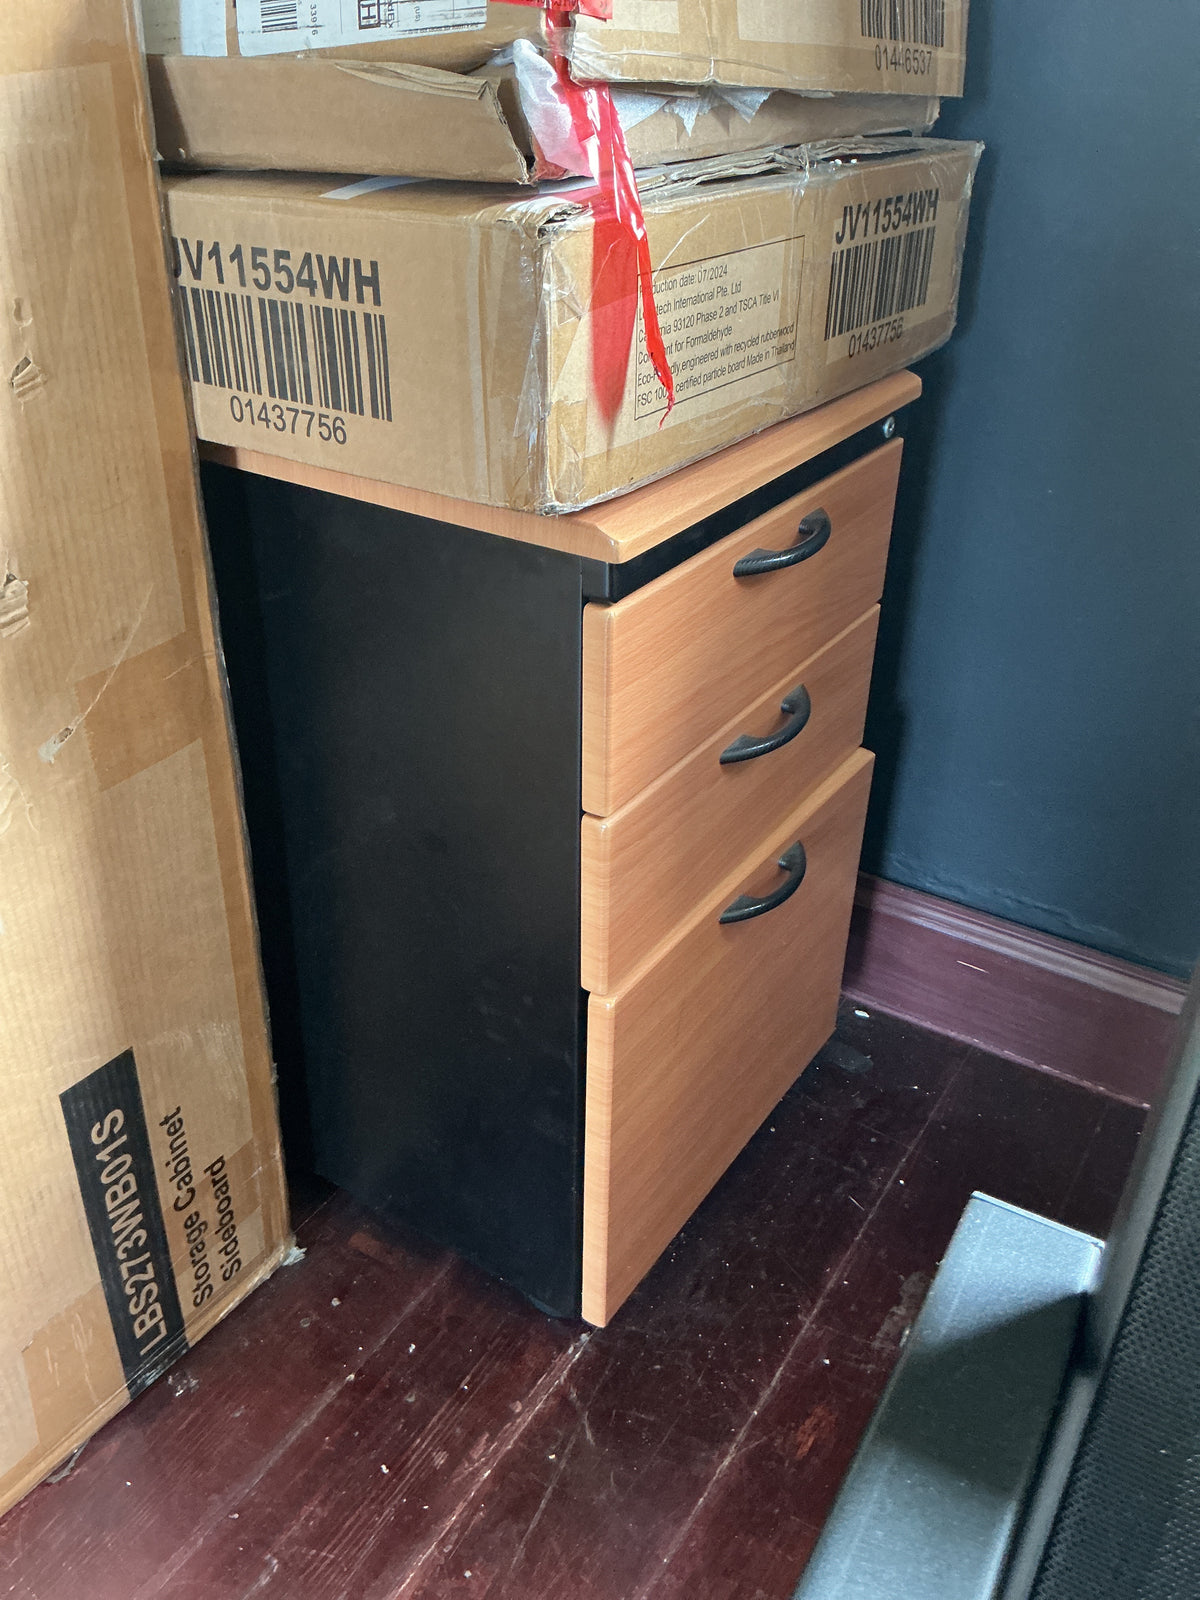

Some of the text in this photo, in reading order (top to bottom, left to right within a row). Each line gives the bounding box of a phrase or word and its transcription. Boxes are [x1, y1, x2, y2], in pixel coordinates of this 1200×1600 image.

[309, 4, 319, 36] 3396
[835, 188, 938, 245] JV11554WH
[171, 236, 381, 307] JV11554WH
[680, 275, 697, 288] date:
[697, 263, 728, 283] 07/2024
[673, 285, 715, 310] International
[716, 285, 729, 299] Pte.
[731, 280, 741, 295] Ltd
[673, 313, 695, 332] 93120
[696, 311, 717, 326] Phase
[719, 306, 724, 319] 2
[724, 302, 738, 316] and
[739, 296, 757, 313] TSCA
[759, 293, 772, 306] Title
[674, 325, 733, 353] for Formaldehyde
[720, 343, 733, 356] with
[734, 336, 760, 353] recycled
[760, 321, 795, 343] rubberwood
[849, 316, 904, 359] 01437756
[637, 340, 795, 408] FSC 100 certified particle board Made in Thailand
[230, 395, 347, 445] 01437756
[158, 1105, 214, 1308] Storage Cabinet
[203, 1154, 241, 1282] Sideboard
[90, 1108, 168, 1355] LBS273WB01S
